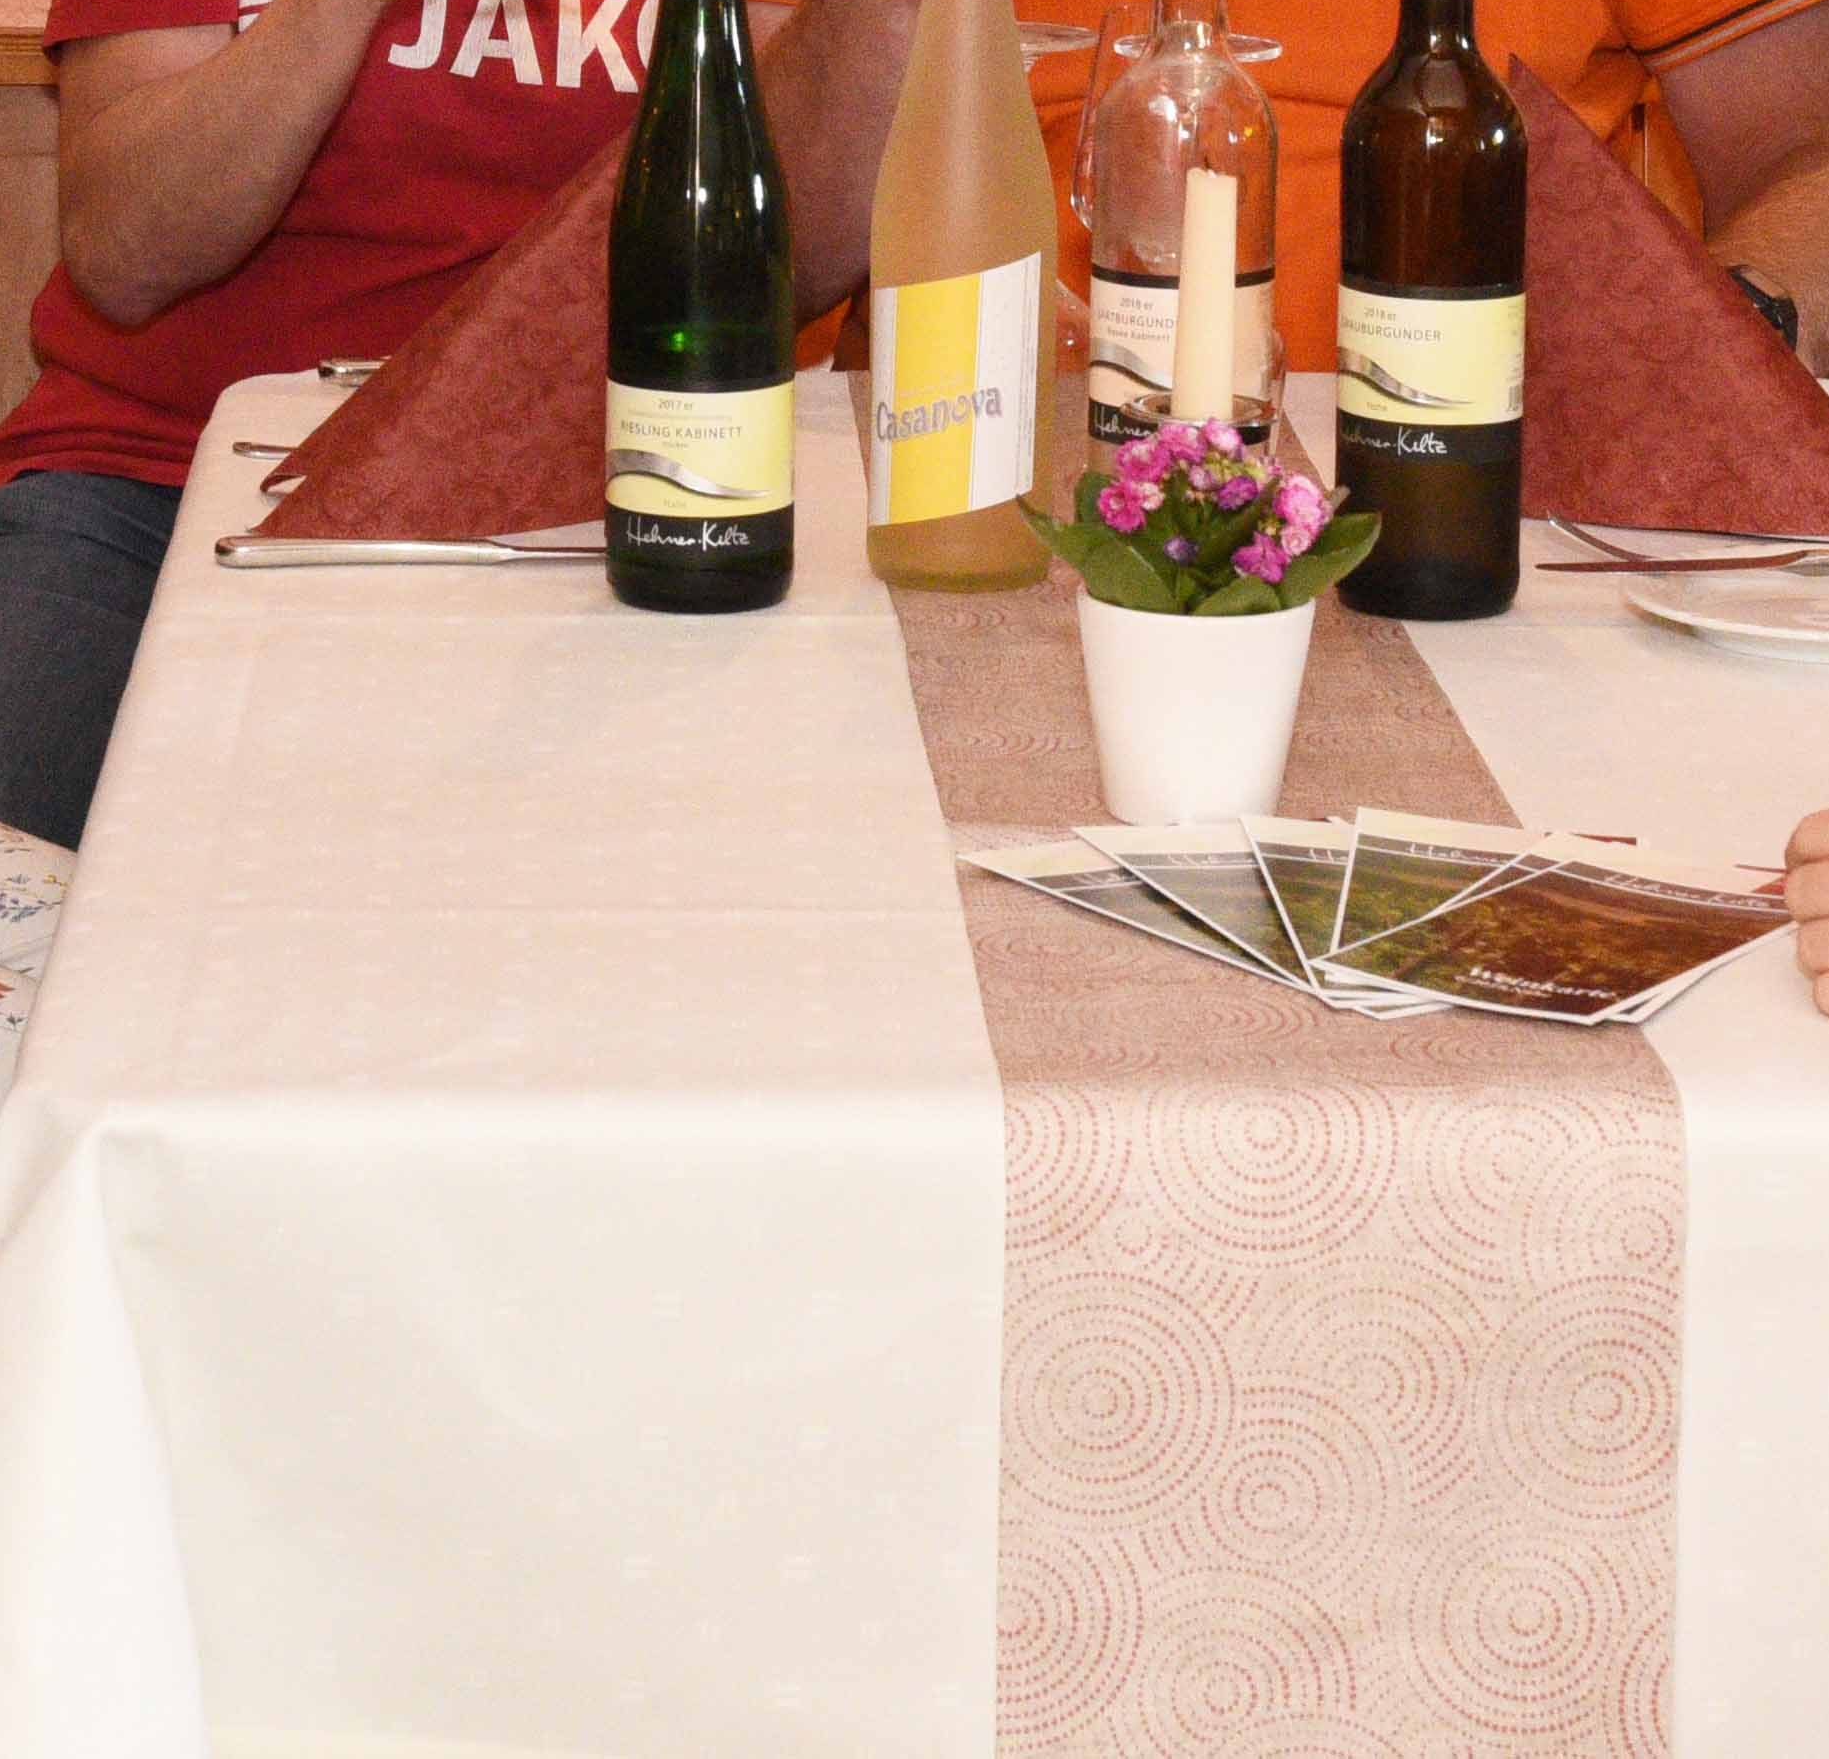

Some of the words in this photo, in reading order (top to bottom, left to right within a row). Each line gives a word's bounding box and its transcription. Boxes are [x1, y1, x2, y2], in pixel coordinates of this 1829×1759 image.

[621, 419, 671, 438] RIESLING
[675, 425, 742, 441] KABINETT
[875, 387, 1003, 442] Casanova
